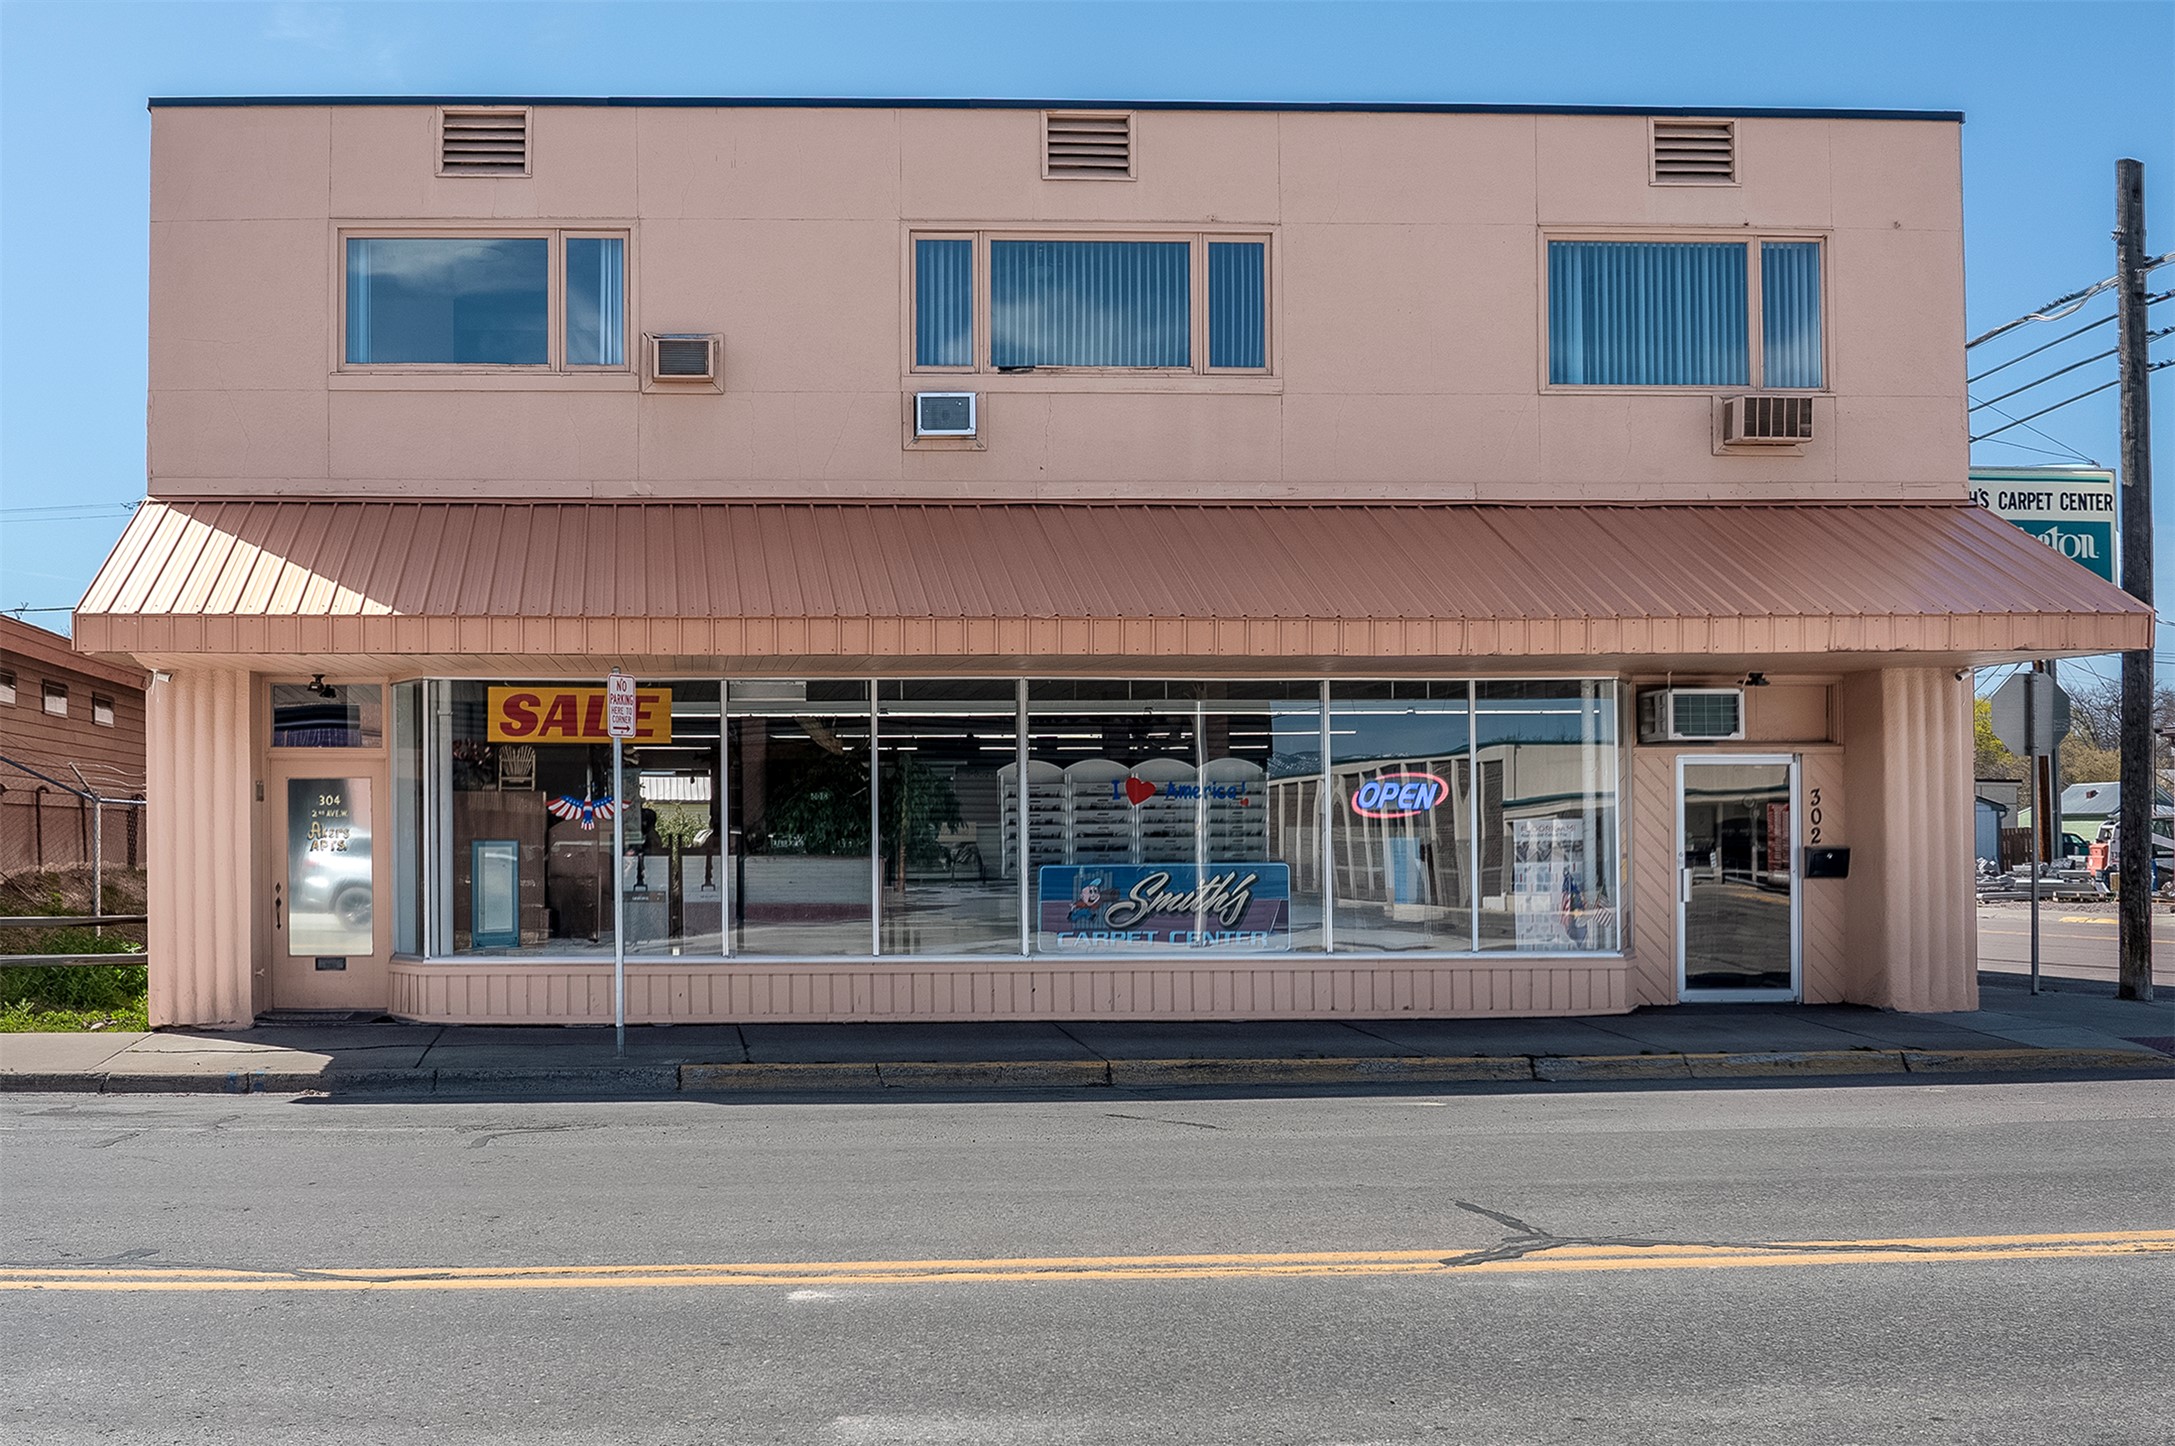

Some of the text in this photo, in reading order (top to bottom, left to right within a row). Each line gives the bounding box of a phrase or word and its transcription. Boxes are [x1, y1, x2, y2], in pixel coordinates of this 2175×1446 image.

[1998, 491, 2053, 511] CARPET
[2060, 491, 2113, 512] CENTER
[616, 680, 627, 692] NO
[609, 693, 634, 706] PARKING
[499, 693, 660, 738] SALE
[611, 706, 633, 716] HERE TO
[611, 715, 632, 724] CORNER
[1111, 780, 1120, 800] I
[1358, 782, 1439, 810] OPEN
[319, 794, 341, 806] 304
[1810, 788, 1823, 845] 302
[1104, 870, 1259, 930] Smith's
[1057, 930, 1268, 948] CARPET CENTER
